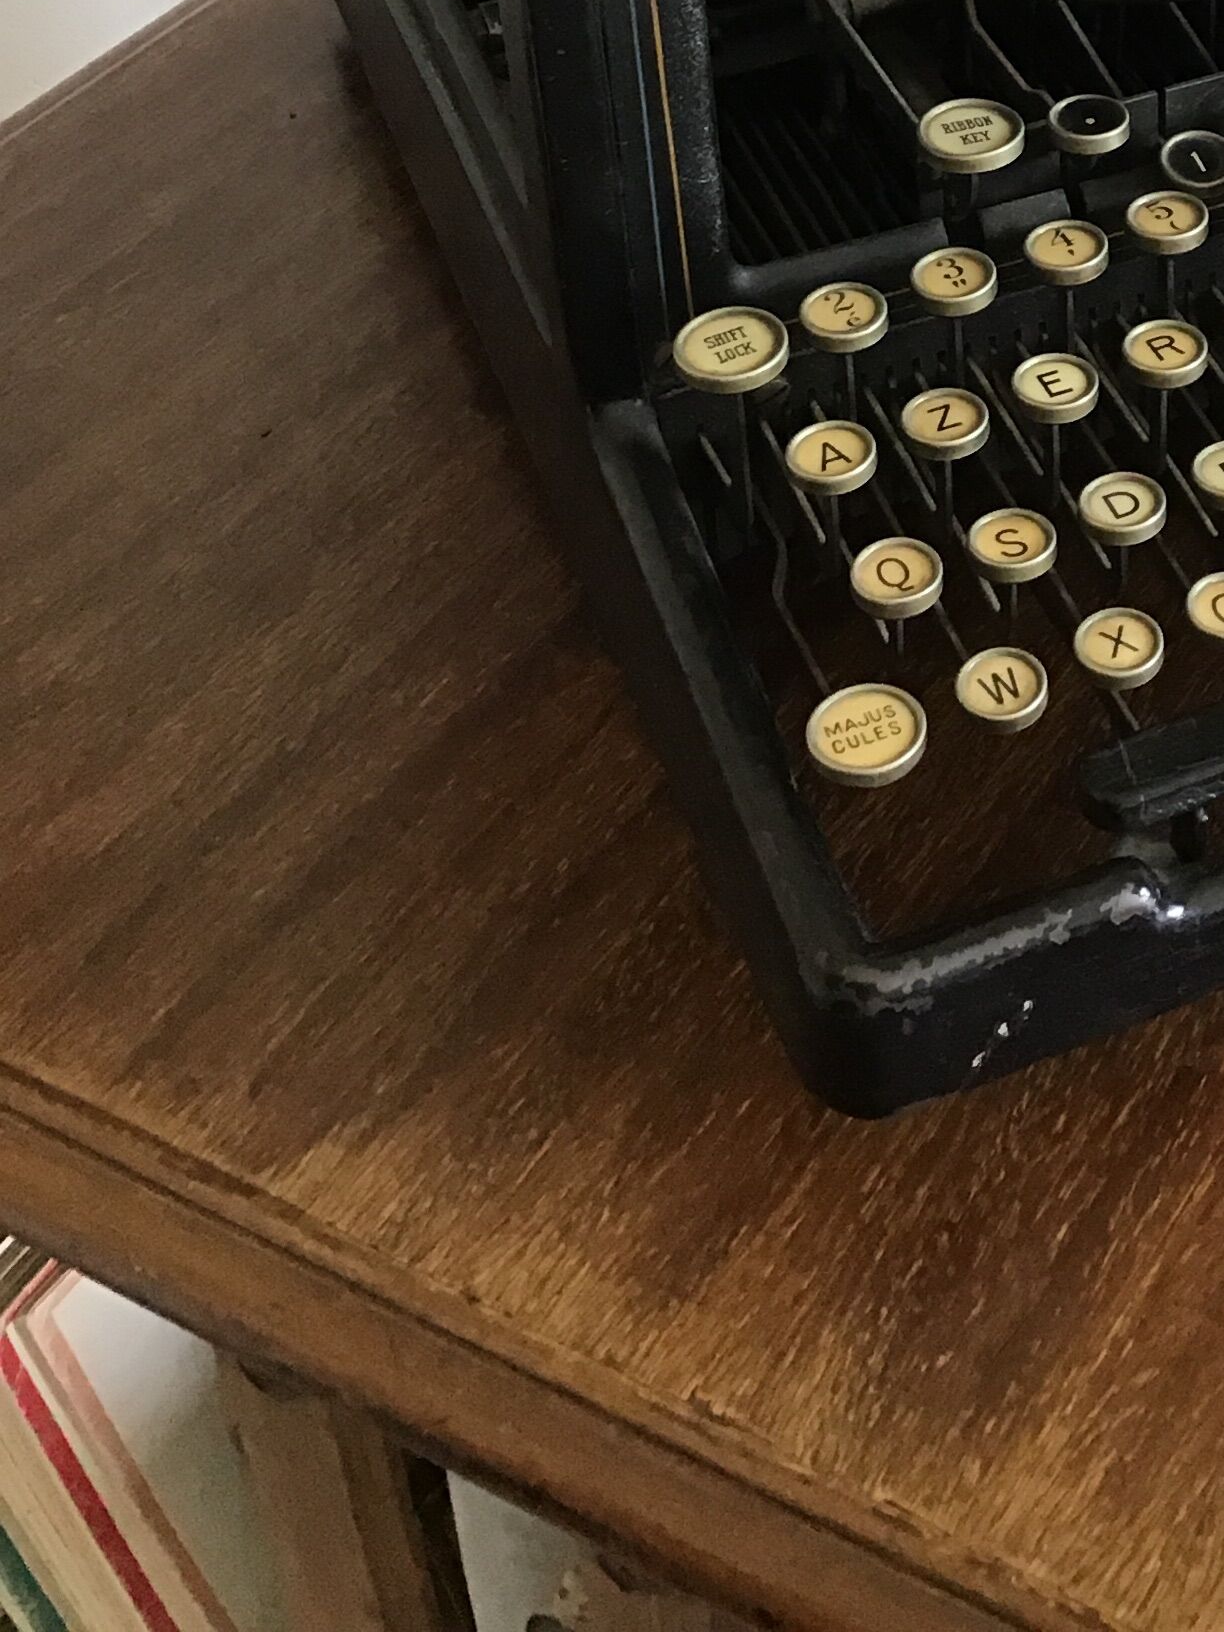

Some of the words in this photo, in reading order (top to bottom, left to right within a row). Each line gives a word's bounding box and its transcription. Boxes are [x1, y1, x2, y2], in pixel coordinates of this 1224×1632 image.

[941, 115, 993, 135] RIBBON
[960, 130, 990, 146] KEY
[1146, 201, 1173, 219] 5
[1051, 228, 1075, 247] 4
[936, 257, 964, 279] 3
[824, 291, 854, 314] 2
[703, 326, 747, 349] SHIFT
[1146, 334, 1185, 362] R
[713, 342, 757, 364] LOCK
[1036, 369, 1074, 399] E
[927, 403, 963, 433] Z
[820, 441, 853, 473] A
[1102, 490, 1141, 520] D
[995, 528, 1029, 558] S
[876, 556, 916, 593] Q
[1097, 624, 1140, 659] X
[976, 666, 1021, 706] W
[823, 703, 897, 739] MAJUS
[831, 719, 902, 755] CULES
